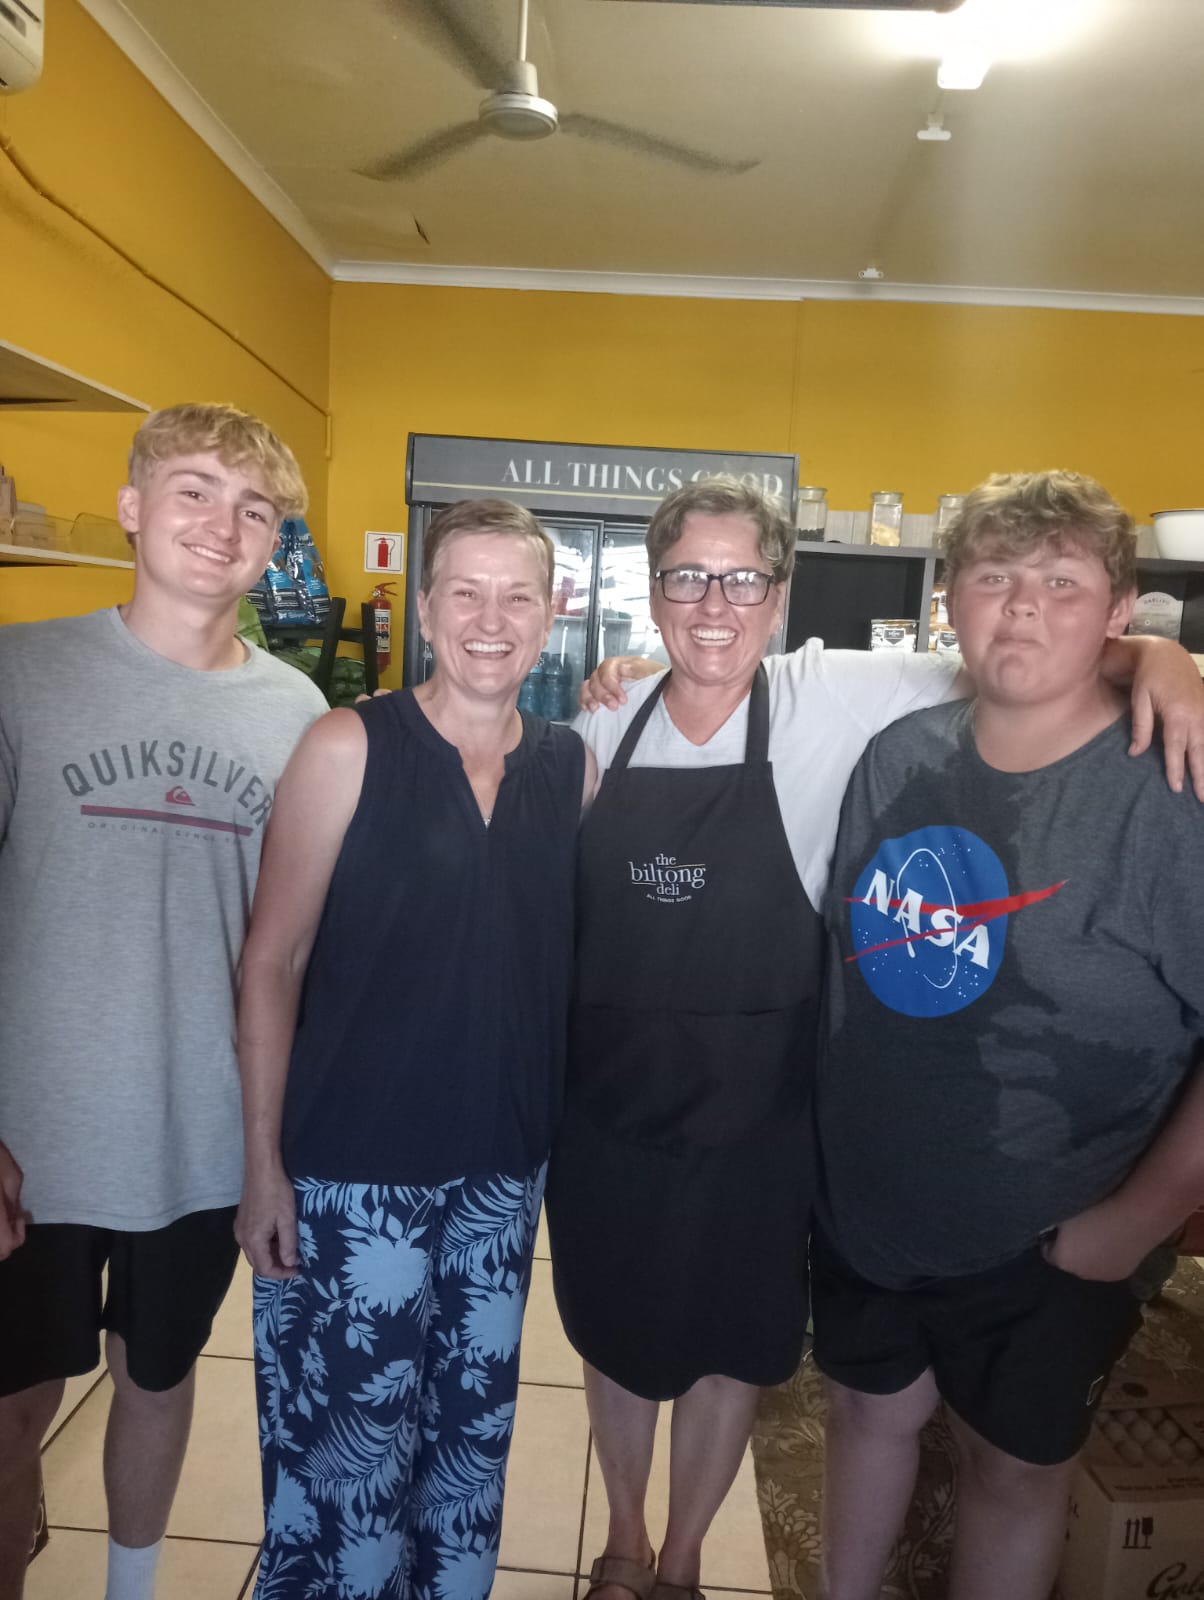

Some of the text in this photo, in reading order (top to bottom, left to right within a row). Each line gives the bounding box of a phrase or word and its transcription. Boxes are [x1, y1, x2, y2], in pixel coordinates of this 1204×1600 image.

[501, 459, 560, 486] ALL
[567, 462, 682, 492] THINGS
[62, 740, 273, 826] QUIKSILVER
[656, 853, 677, 866] the
[628, 861, 706, 889] biltong
[656, 883, 680, 896] deli
[862, 868, 990, 970] NASA
